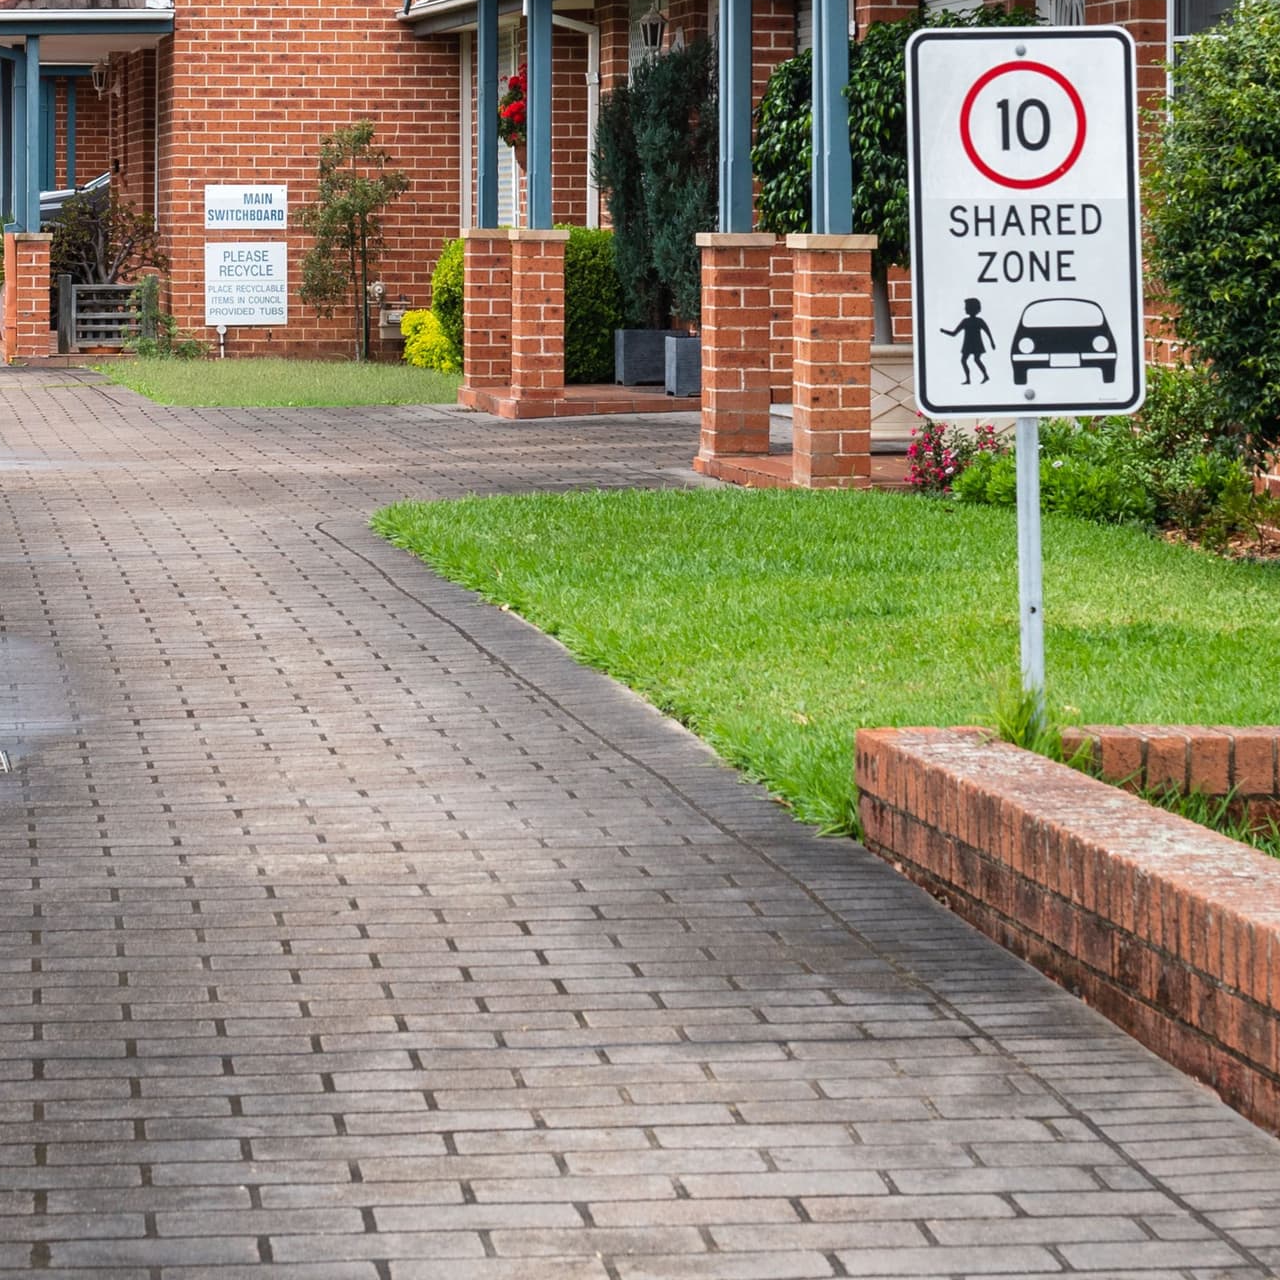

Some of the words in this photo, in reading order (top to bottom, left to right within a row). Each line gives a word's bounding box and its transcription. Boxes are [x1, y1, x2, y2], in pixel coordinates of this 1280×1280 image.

[996, 98, 1051, 152] 10
[243, 193, 273, 204] MAIN
[208, 209, 284, 221] SWITCHBOARD
[949, 203, 1103, 238] SHARED
[223, 250, 269, 263] PLEASE
[219, 264, 274, 277] RECYCLE
[977, 250, 1077, 283] ZONE
[208, 285, 233, 293] PLACE
[236, 285, 285, 293] RECYCLABLE
[211, 296, 234, 304] ITEMS
[237, 296, 246, 304] IN
[248, 296, 282, 304] COUNCIL
[209, 307, 256, 316] PROVIDED
[260, 307, 284, 316] TUBS
